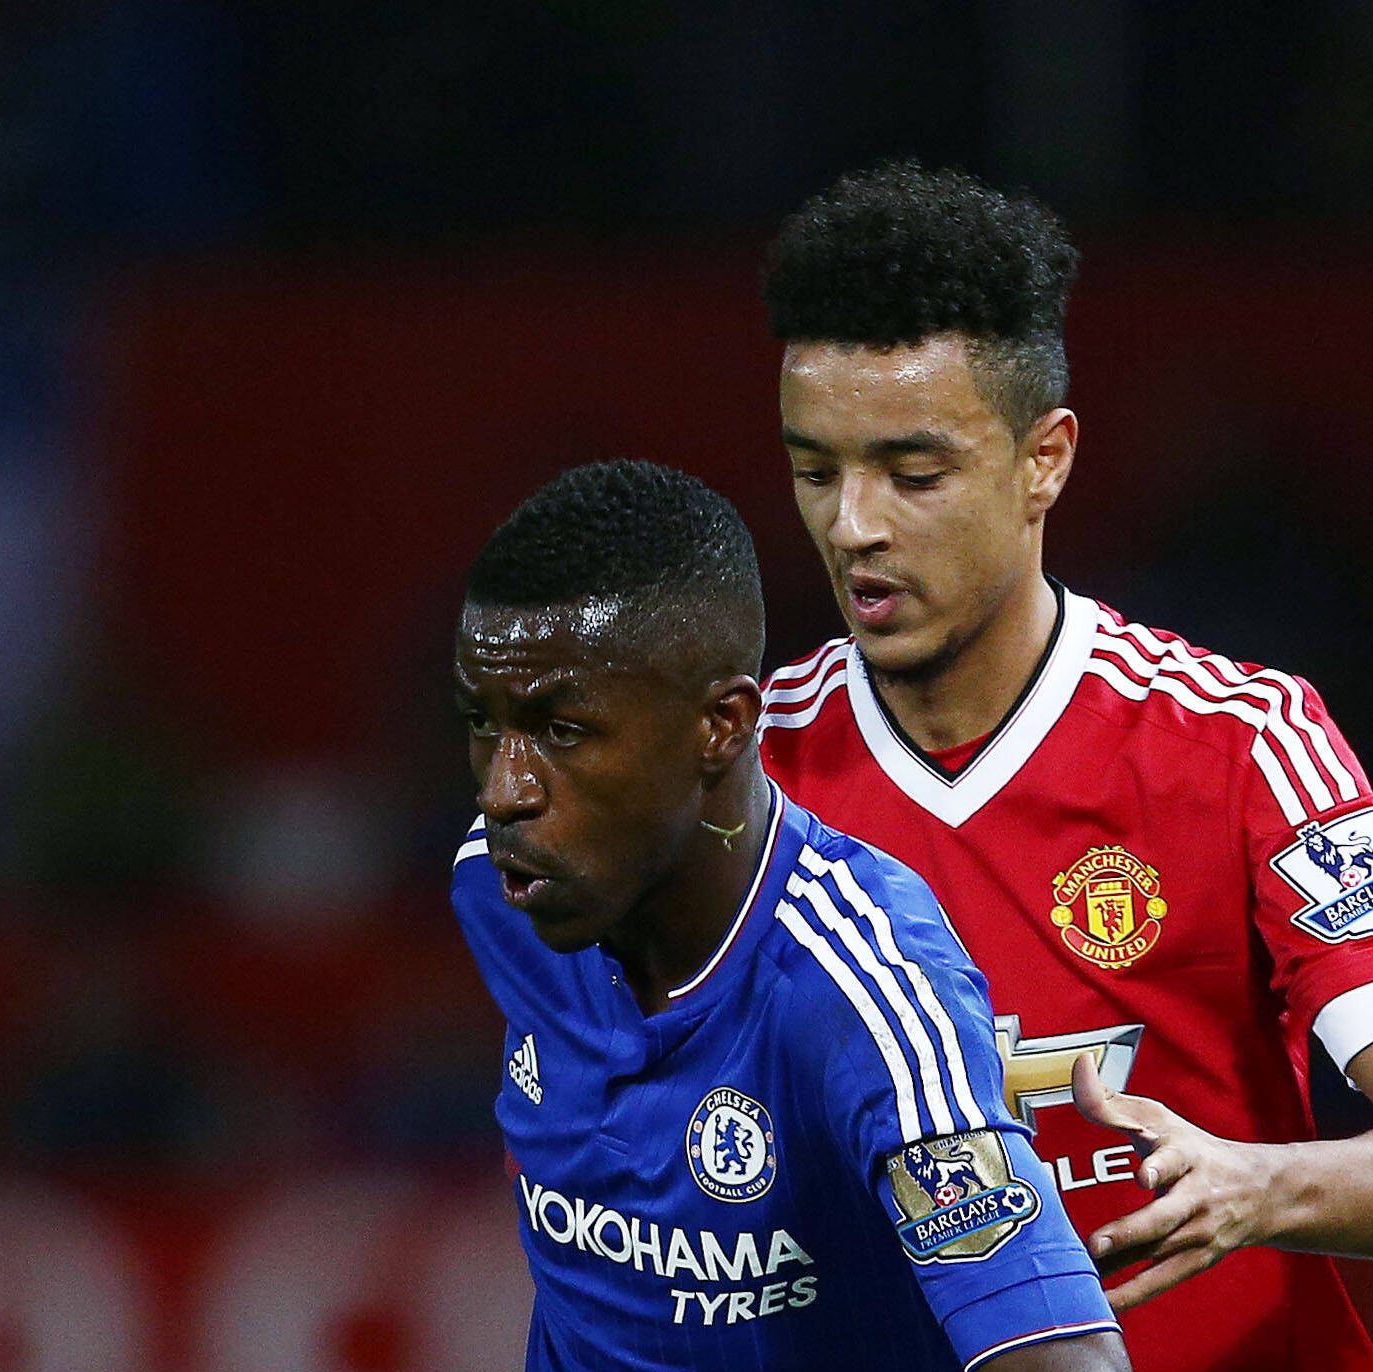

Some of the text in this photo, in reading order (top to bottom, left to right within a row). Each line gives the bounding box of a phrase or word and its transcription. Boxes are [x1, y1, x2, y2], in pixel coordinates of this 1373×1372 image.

[1061, 854, 1153, 897] MANCHESTER
[1081, 936, 1147, 961] UNITED
[508, 1060, 543, 1105] adidas
[706, 1090, 761, 1121] CHELSEA
[698, 1172, 767, 1197] FOOTBALL CLUB
[1041, 1144, 1135, 1192] LE
[520, 1173, 815, 1282] YOKOHAMA
[916, 1194, 998, 1241] BARCLAYS
[670, 1276, 818, 1326] TYRES
